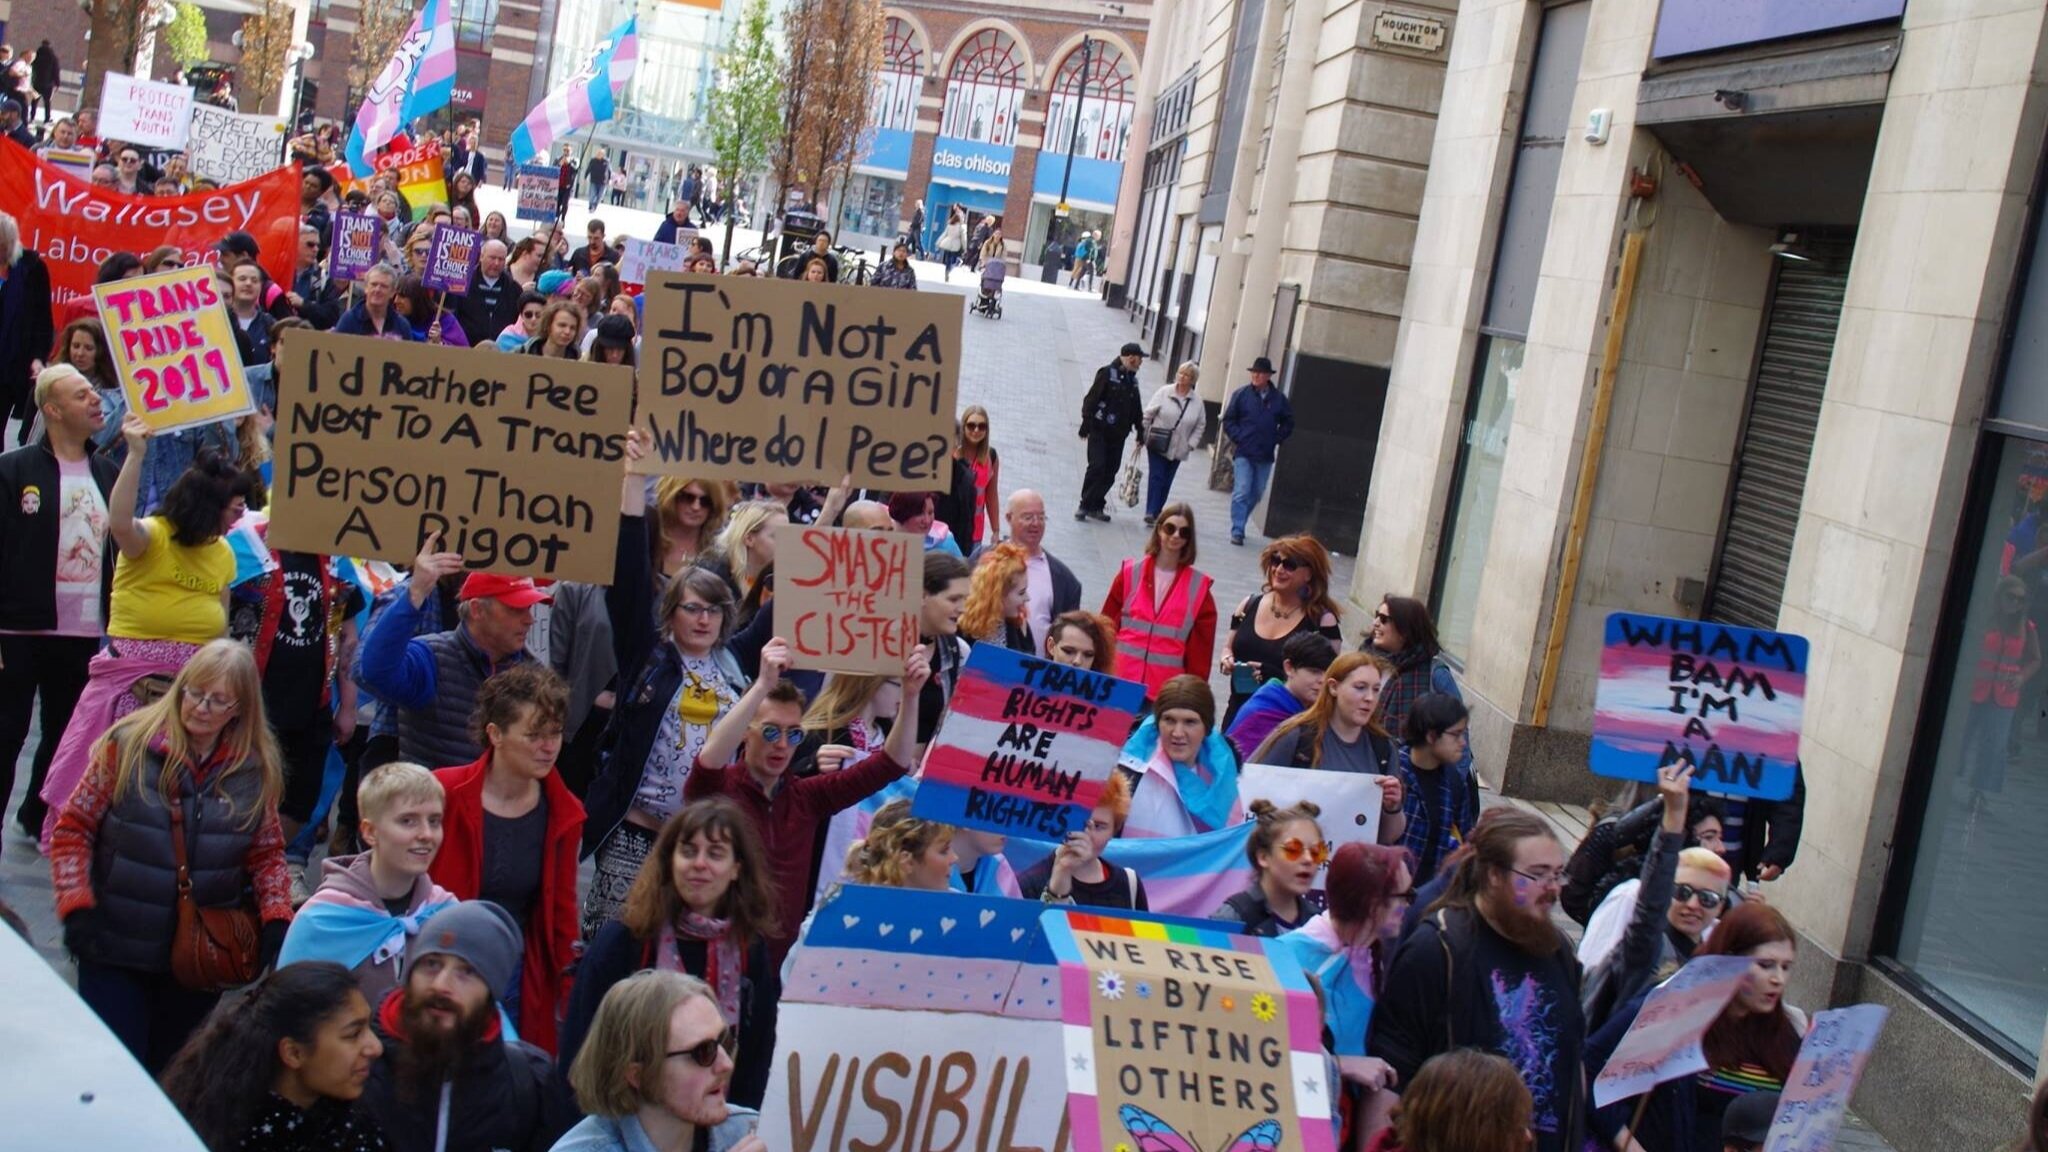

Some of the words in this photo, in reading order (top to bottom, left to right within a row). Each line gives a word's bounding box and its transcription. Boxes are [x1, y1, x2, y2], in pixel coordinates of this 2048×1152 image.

[1382, 19, 1438, 36] HOUGHTON
[1392, 32, 1422, 45] LANE
[130, 86, 186, 107] PROTECT
[139, 106, 173, 122] TRANS
[450, 88, 473, 100] OSTA
[192, 107, 263, 135] RESPECT
[221, 147, 282, 168] EXPECT
[373, 140, 442, 172] ORDER
[933, 149, 963, 169] clas
[964, 153, 1011, 176] ohlson
[34, 167, 262, 230] Wallasey
[339, 230, 352, 248] IS
[352, 231, 373, 249] NOT
[340, 216, 375, 233] TRANS
[441, 228, 476, 248] TRANS
[345, 248, 372, 261] CHOICE
[436, 241, 451, 260] IS
[450, 245, 471, 262] NOT
[441, 259, 469, 275] CHOICE
[638, 241, 680, 261] TRANS
[105, 277, 218, 324] TRANS
[119, 319, 205, 364] PRIDE
[798, 300, 897, 361] Not
[904, 323, 943, 365] A
[132, 348, 231, 412] 2019
[380, 361, 507, 407] Rather
[525, 372, 600, 416] Pee
[661, 346, 746, 404] Boy
[758, 363, 799, 399] or
[802, 369, 835, 405] A
[847, 361, 942, 416] Girl
[290, 402, 382, 440] Next
[391, 404, 433, 440] To
[440, 413, 483, 449] A
[497, 416, 626, 462] Trans
[649, 409, 758, 464] Where
[764, 414, 805, 468] do
[847, 424, 948, 481] Pee?
[287, 442, 448, 512] Person
[465, 468, 595, 534] Than
[334, 505, 383, 551] A
[416, 511, 571, 574] Bigot
[790, 528, 908, 600] SMASH
[824, 590, 876, 614] THE
[1618, 617, 1797, 673] WHAM
[1018, 658, 1117, 703] TRANS
[1669, 653, 1777, 701] BAM
[1001, 687, 1099, 732] RIGHTS
[1667, 685, 1739, 722] I'M
[996, 721, 1057, 760] ARE
[1682, 716, 1713, 742] A
[980, 750, 1082, 801] HUMAN
[1658, 739, 1767, 789] MAN
[1085, 937, 1146, 966] WE
[1164, 947, 1257, 982] RISE
[1163, 977, 1213, 1012] BY
[1103, 1014, 1283, 1069] LIFTING
[1118, 1063, 1281, 1116] OTHERS
